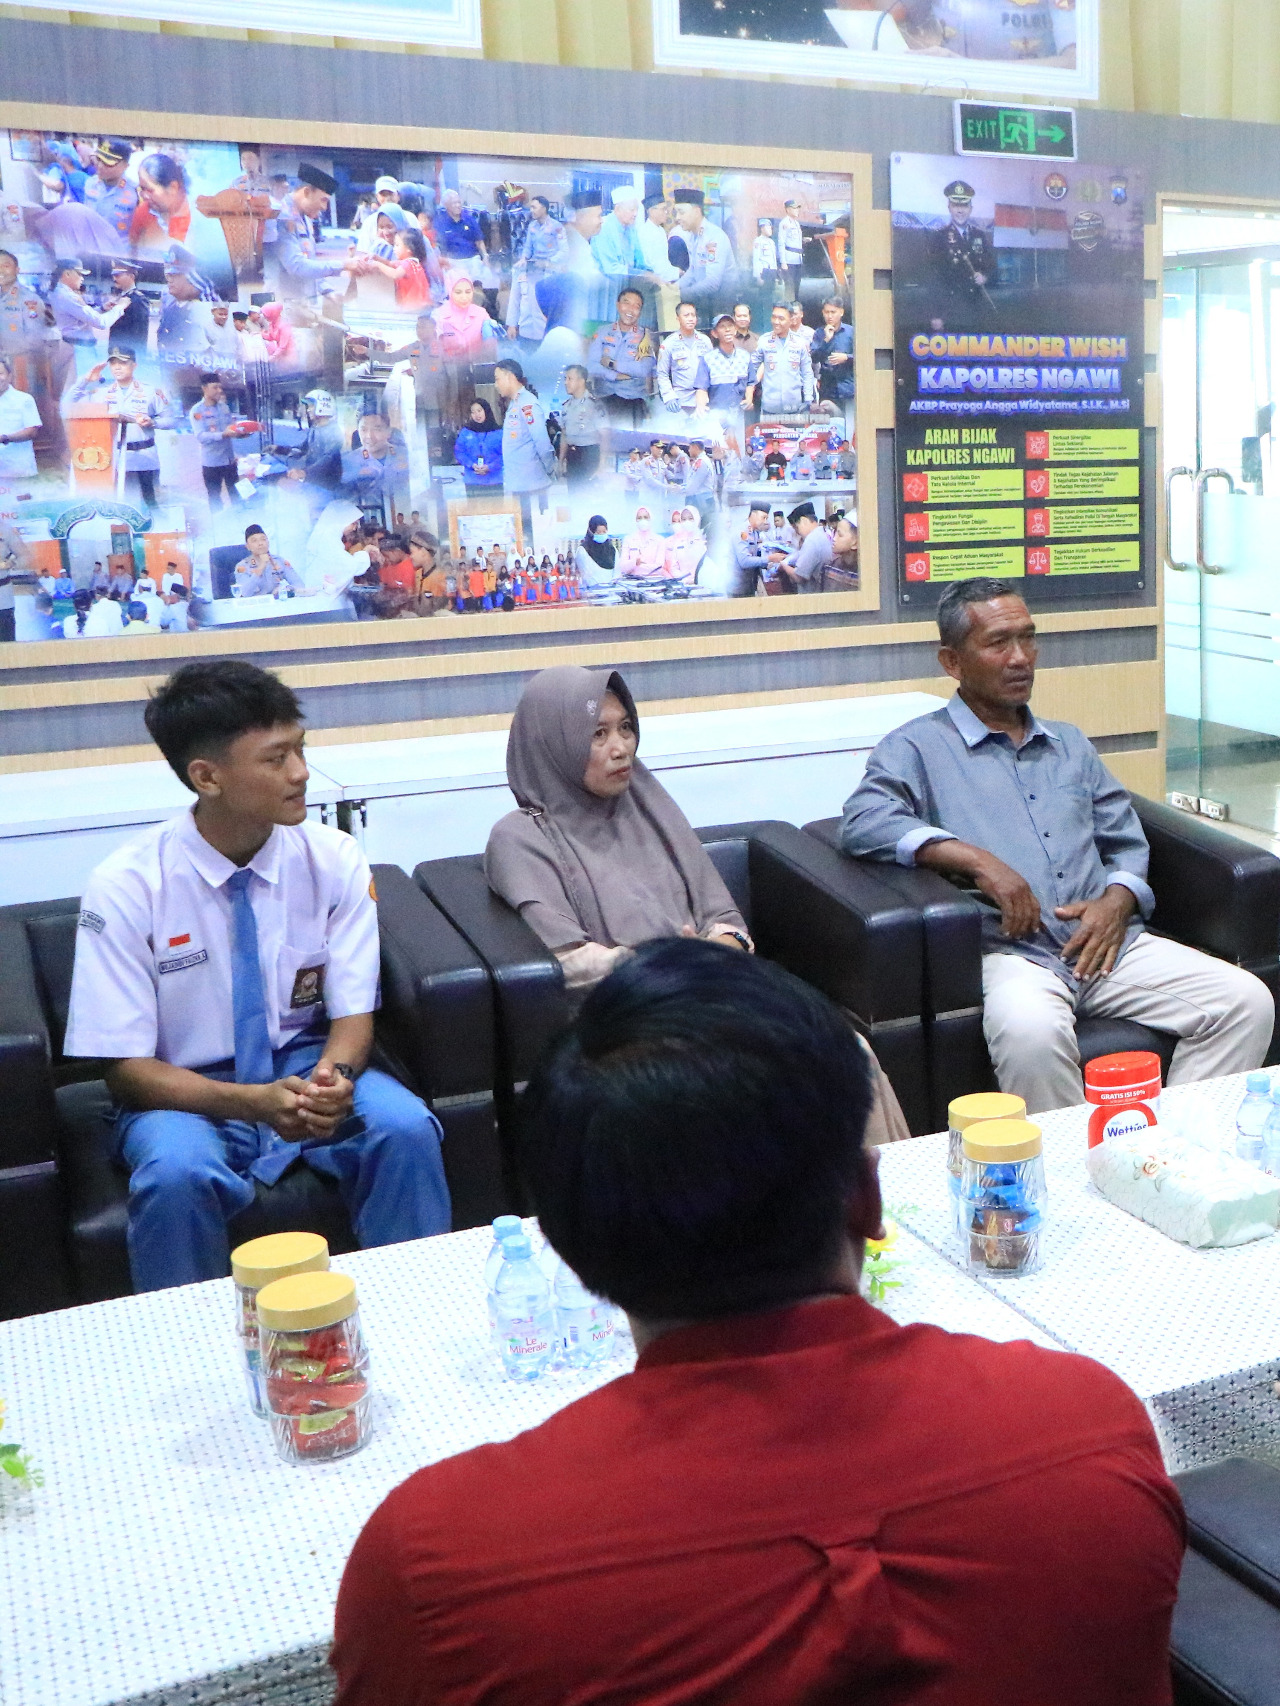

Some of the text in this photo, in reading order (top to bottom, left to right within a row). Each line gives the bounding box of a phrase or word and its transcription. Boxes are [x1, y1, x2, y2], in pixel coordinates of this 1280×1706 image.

[966, 119, 997, 139] EXIT
[912, 334, 1127, 358] COMMANDER WISH
[920, 367, 1120, 389] KAPOLRES NGAWI
[909, 400, 938, 412] AKBP
[939, 400, 983, 415] Prayoga
[984, 400, 1018, 414] Angga
[924, 428, 997, 445] ARAH BIJAK
[906, 447, 1016, 466] KAPOLRES NGAWI
[1100, 1092, 1124, 1100] GRATIS
[1133, 1089, 1146, 1097] 50%
[509, 1341, 548, 1354] Minerale
[525, 1337, 537, 1346] Le
